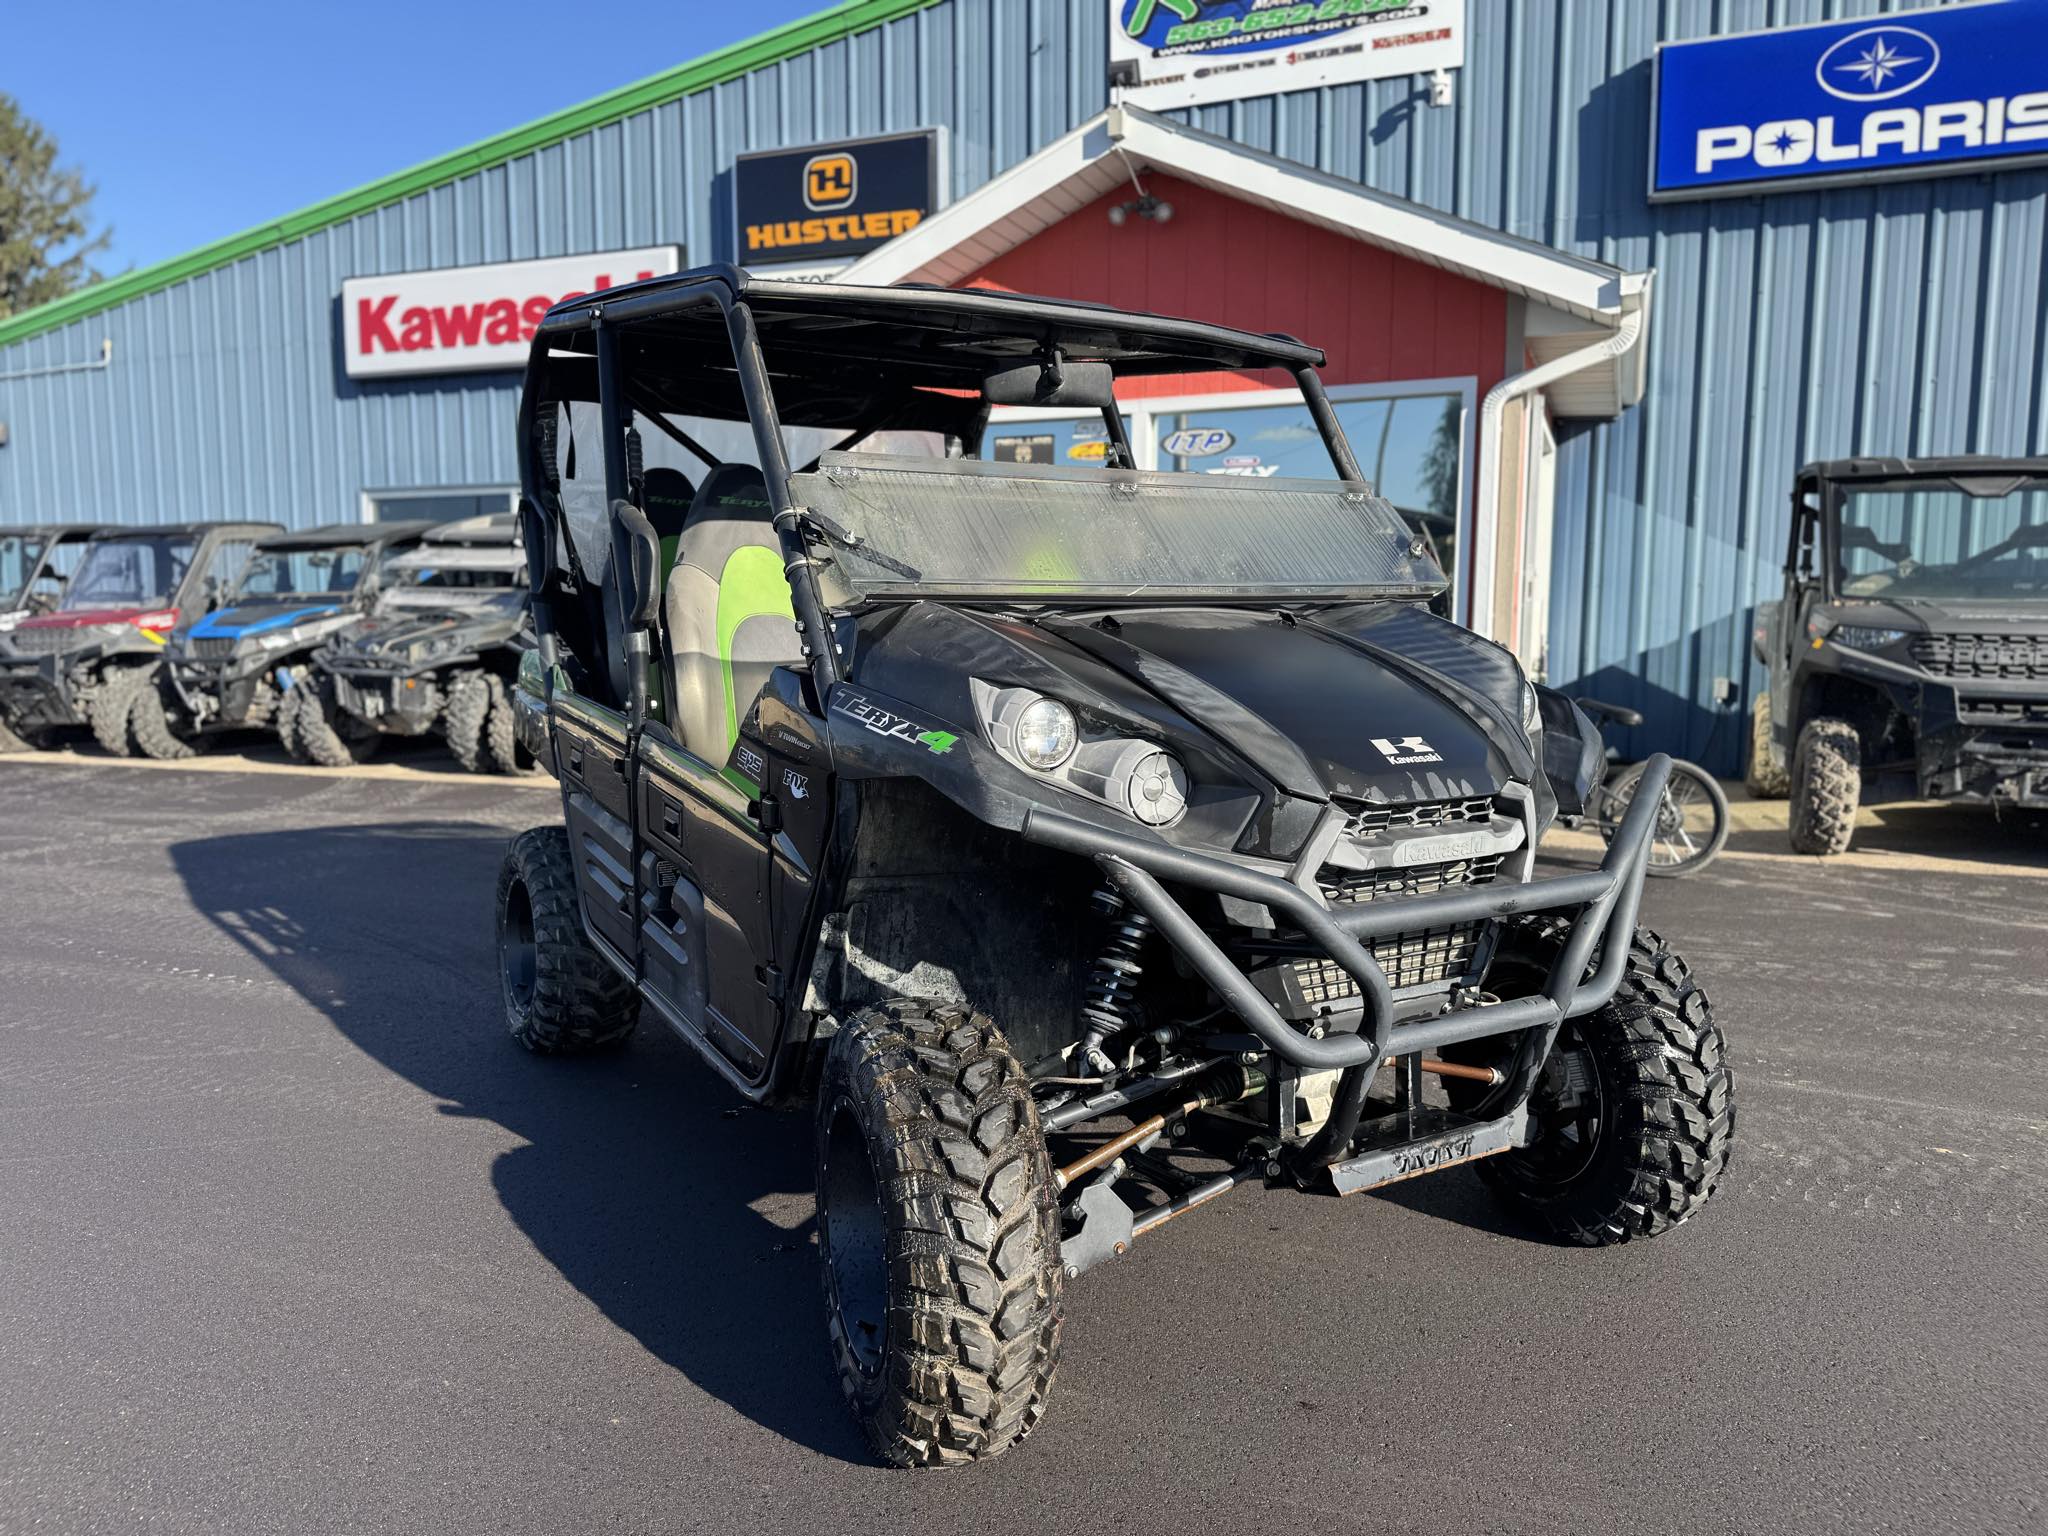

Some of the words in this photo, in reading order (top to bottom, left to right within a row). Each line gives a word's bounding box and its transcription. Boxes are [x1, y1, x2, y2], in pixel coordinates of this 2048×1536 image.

[1695, 91, 2048, 174] POLARIS
[747, 209, 922, 249] HUSTLER
[357, 270, 656, 356] Kawas
[1168, 430, 1226, 453] ITP
[737, 746, 763, 773] EPS
[1385, 752, 1445, 765] Kawasaki
[782, 768, 809, 791] FOX
